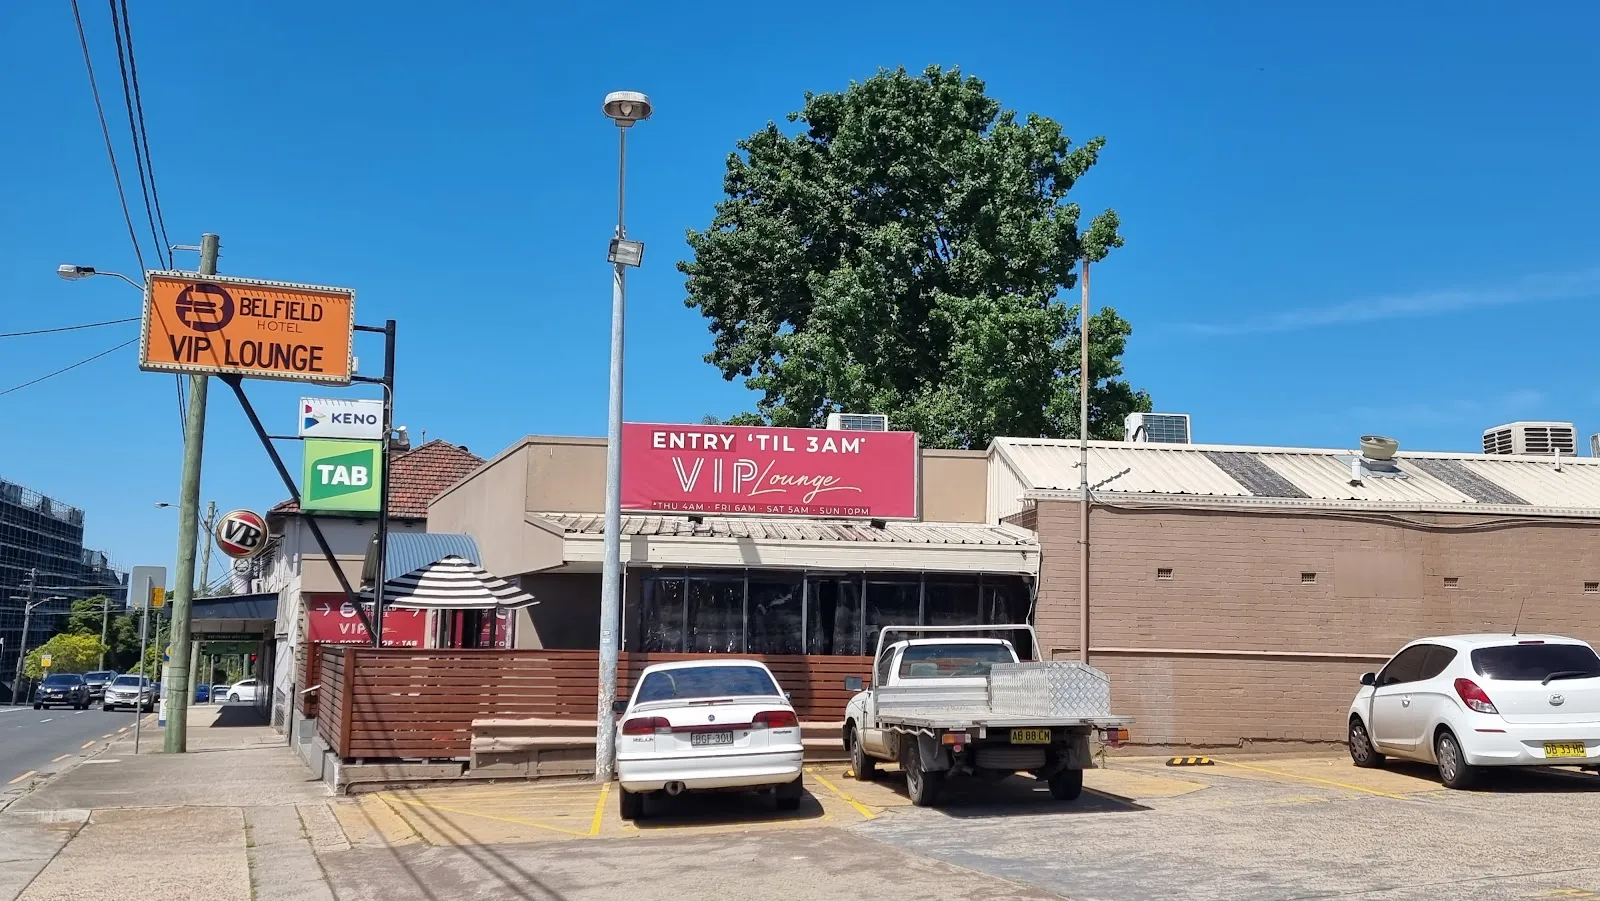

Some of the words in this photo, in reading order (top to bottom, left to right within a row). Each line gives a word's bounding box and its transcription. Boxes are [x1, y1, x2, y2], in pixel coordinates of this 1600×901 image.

[239, 297, 323, 322] BELFIELD
[257, 320, 303, 333] HOTEL
[169, 334, 211, 363] VIP
[224, 339, 324, 372] LOUNGE
[331, 413, 377, 425] KENO
[653, 431, 735, 450] ENTRY
[316, 464, 368, 486] TAB
[671, 456, 759, 494] VIP
[747, 459, 862, 504] Lounge
[682, 502, 704, 511] 4AM
[714, 503, 731, 512] FRI
[734, 504, 756, 513] 6AM
[766, 505, 785, 513] SAT
[788, 505, 809, 514] 5AM
[819, 506, 840, 515] SUN
[843, 506, 869, 515] 10PM
[225, 520, 261, 547] VB
[339, 623, 367, 635] VIP
